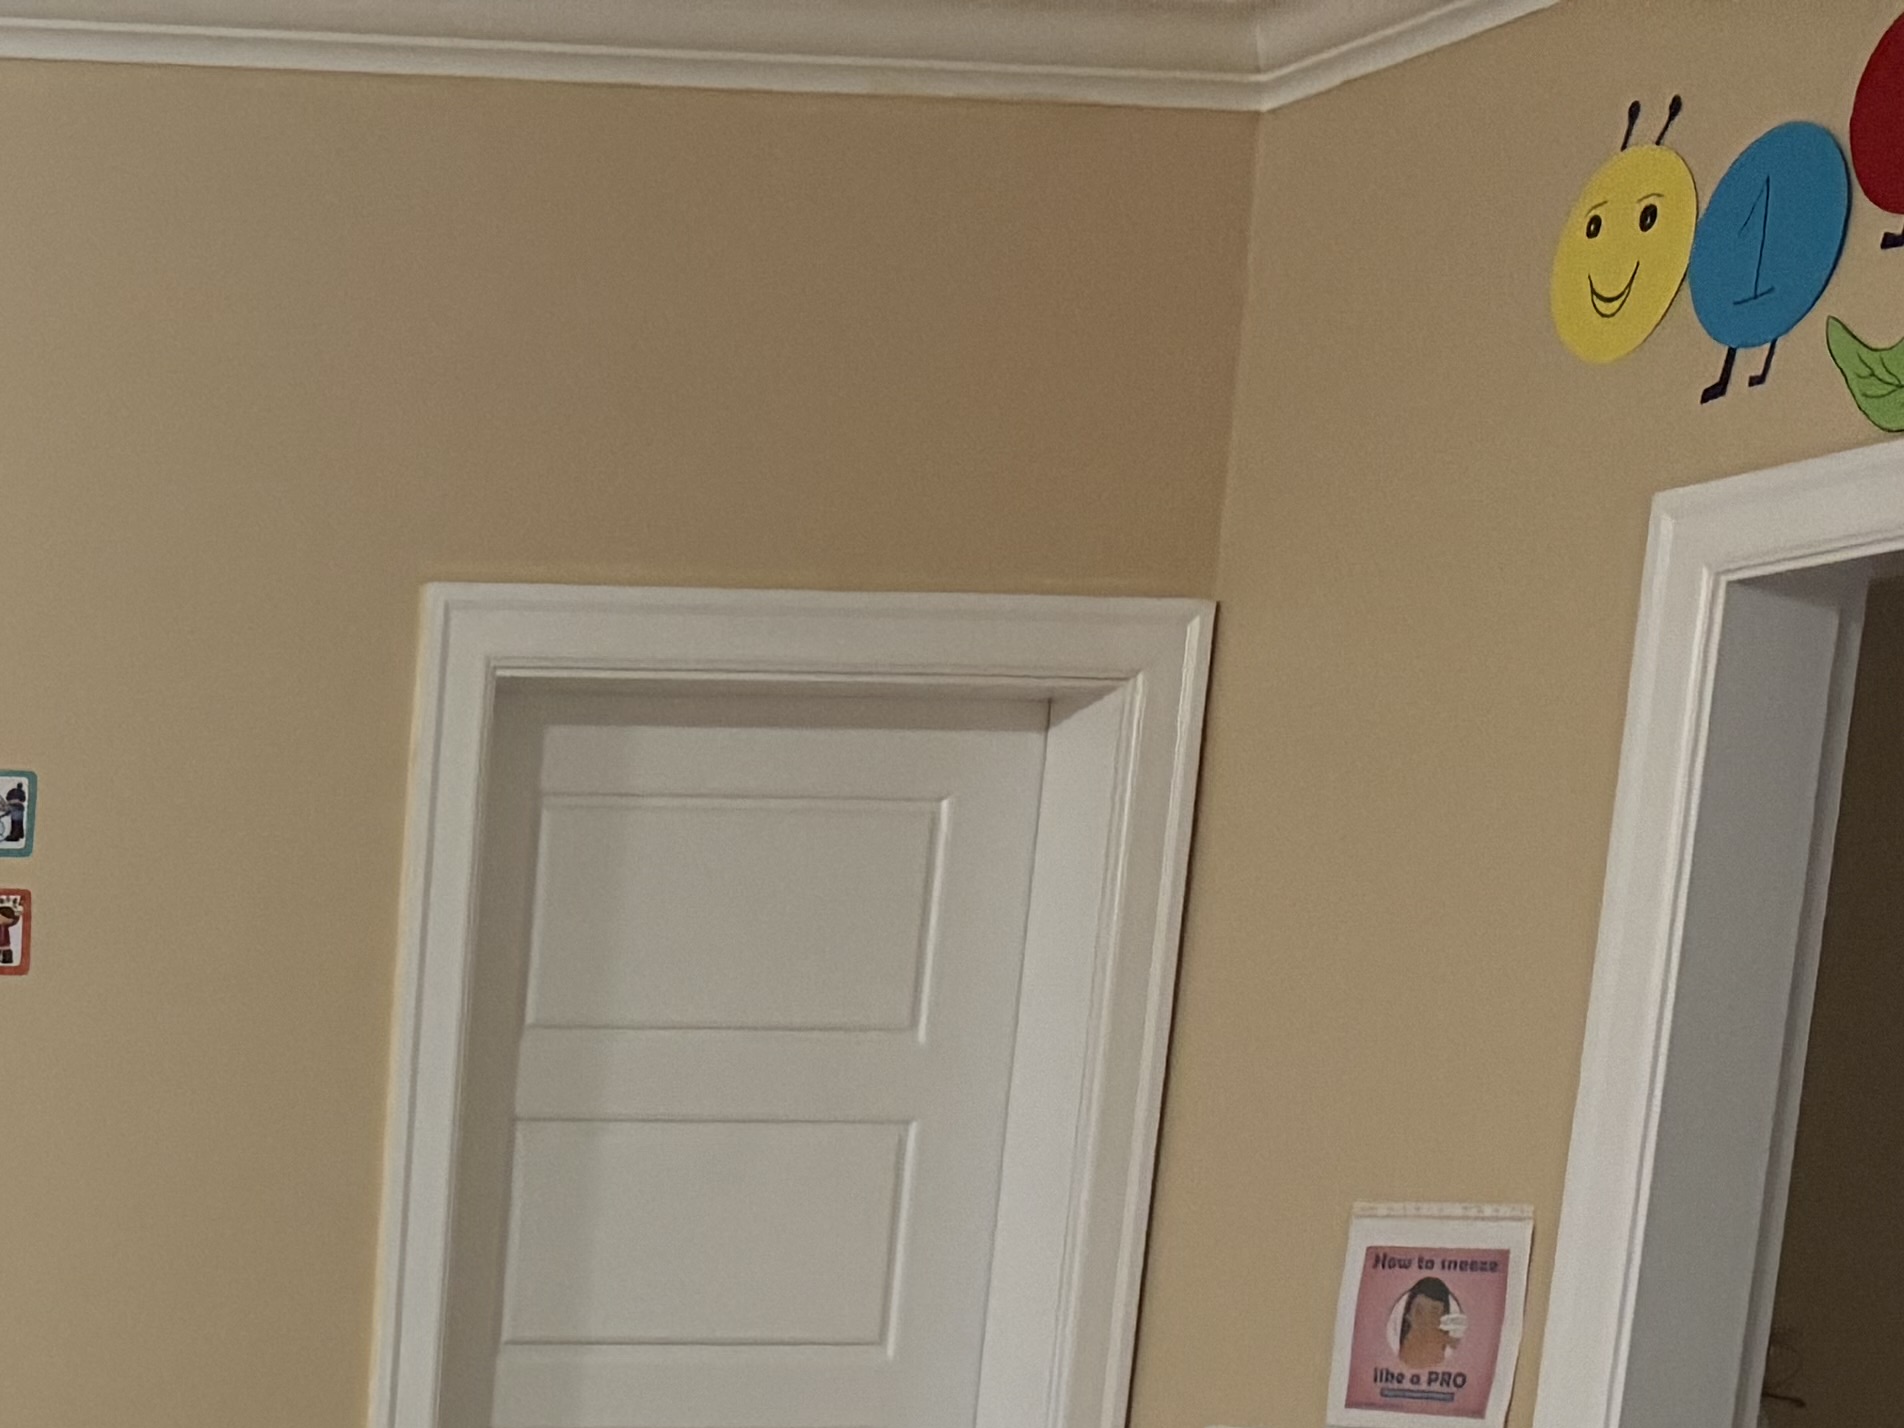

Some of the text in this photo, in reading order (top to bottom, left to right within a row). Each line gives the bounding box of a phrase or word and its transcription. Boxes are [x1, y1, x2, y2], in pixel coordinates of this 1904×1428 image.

[1733, 176, 1775, 305] 1
[1371, 1252, 1412, 1270] How
[1417, 1254, 1435, 1270] to
[1410, 1373, 1422, 1385] a
[1426, 1371, 1467, 1390] PRO
